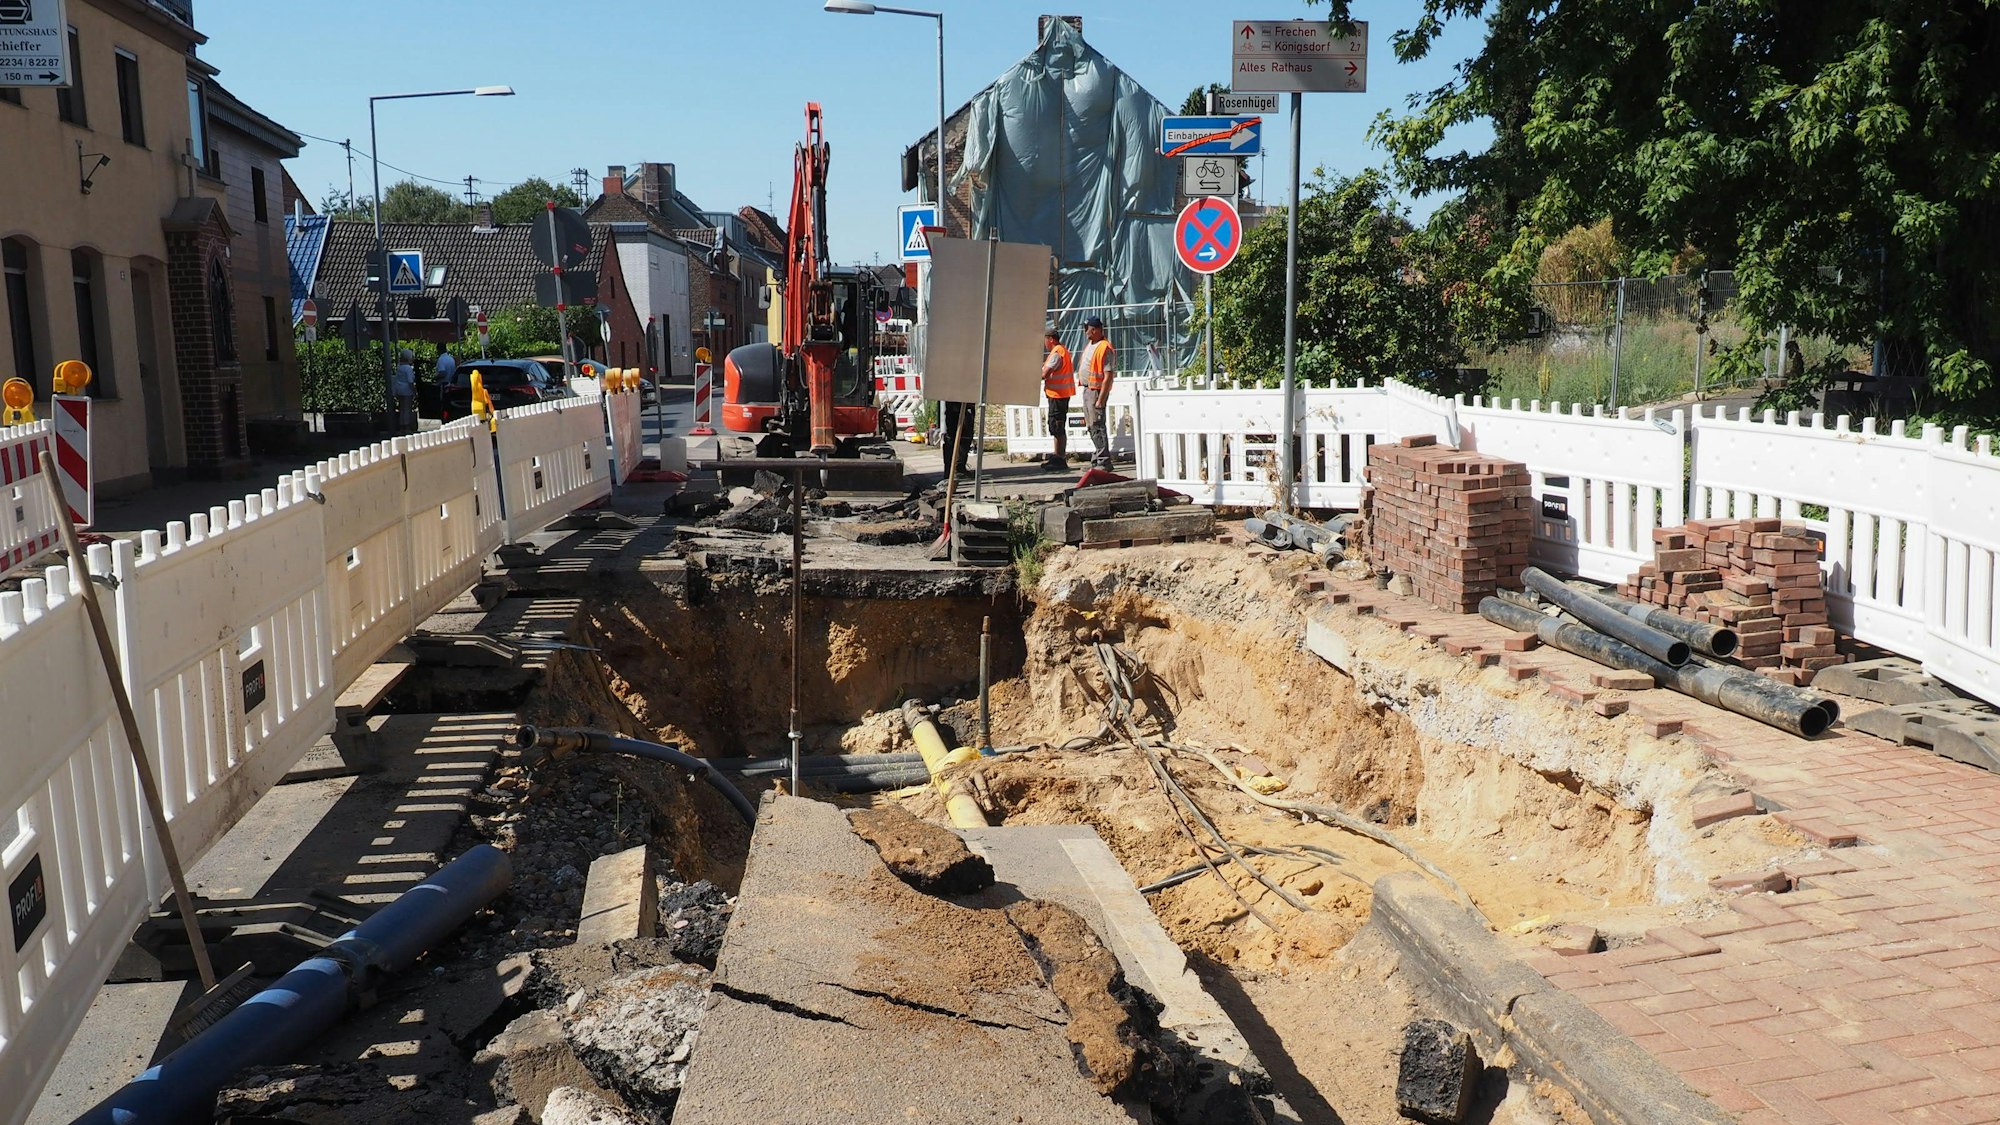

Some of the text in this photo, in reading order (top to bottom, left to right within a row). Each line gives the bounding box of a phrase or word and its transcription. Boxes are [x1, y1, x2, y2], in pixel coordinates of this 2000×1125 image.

[1275, 26, 1316, 37] Frechen
[1275, 41, 1331, 54] Königsdorf
[1350, 41, 1361, 52] 2,7
[1239, 62, 1313, 73] Altes Rathaus
[5, 72, 21, 80] 150
[1219, 96, 1276, 110] Rosenhügel
